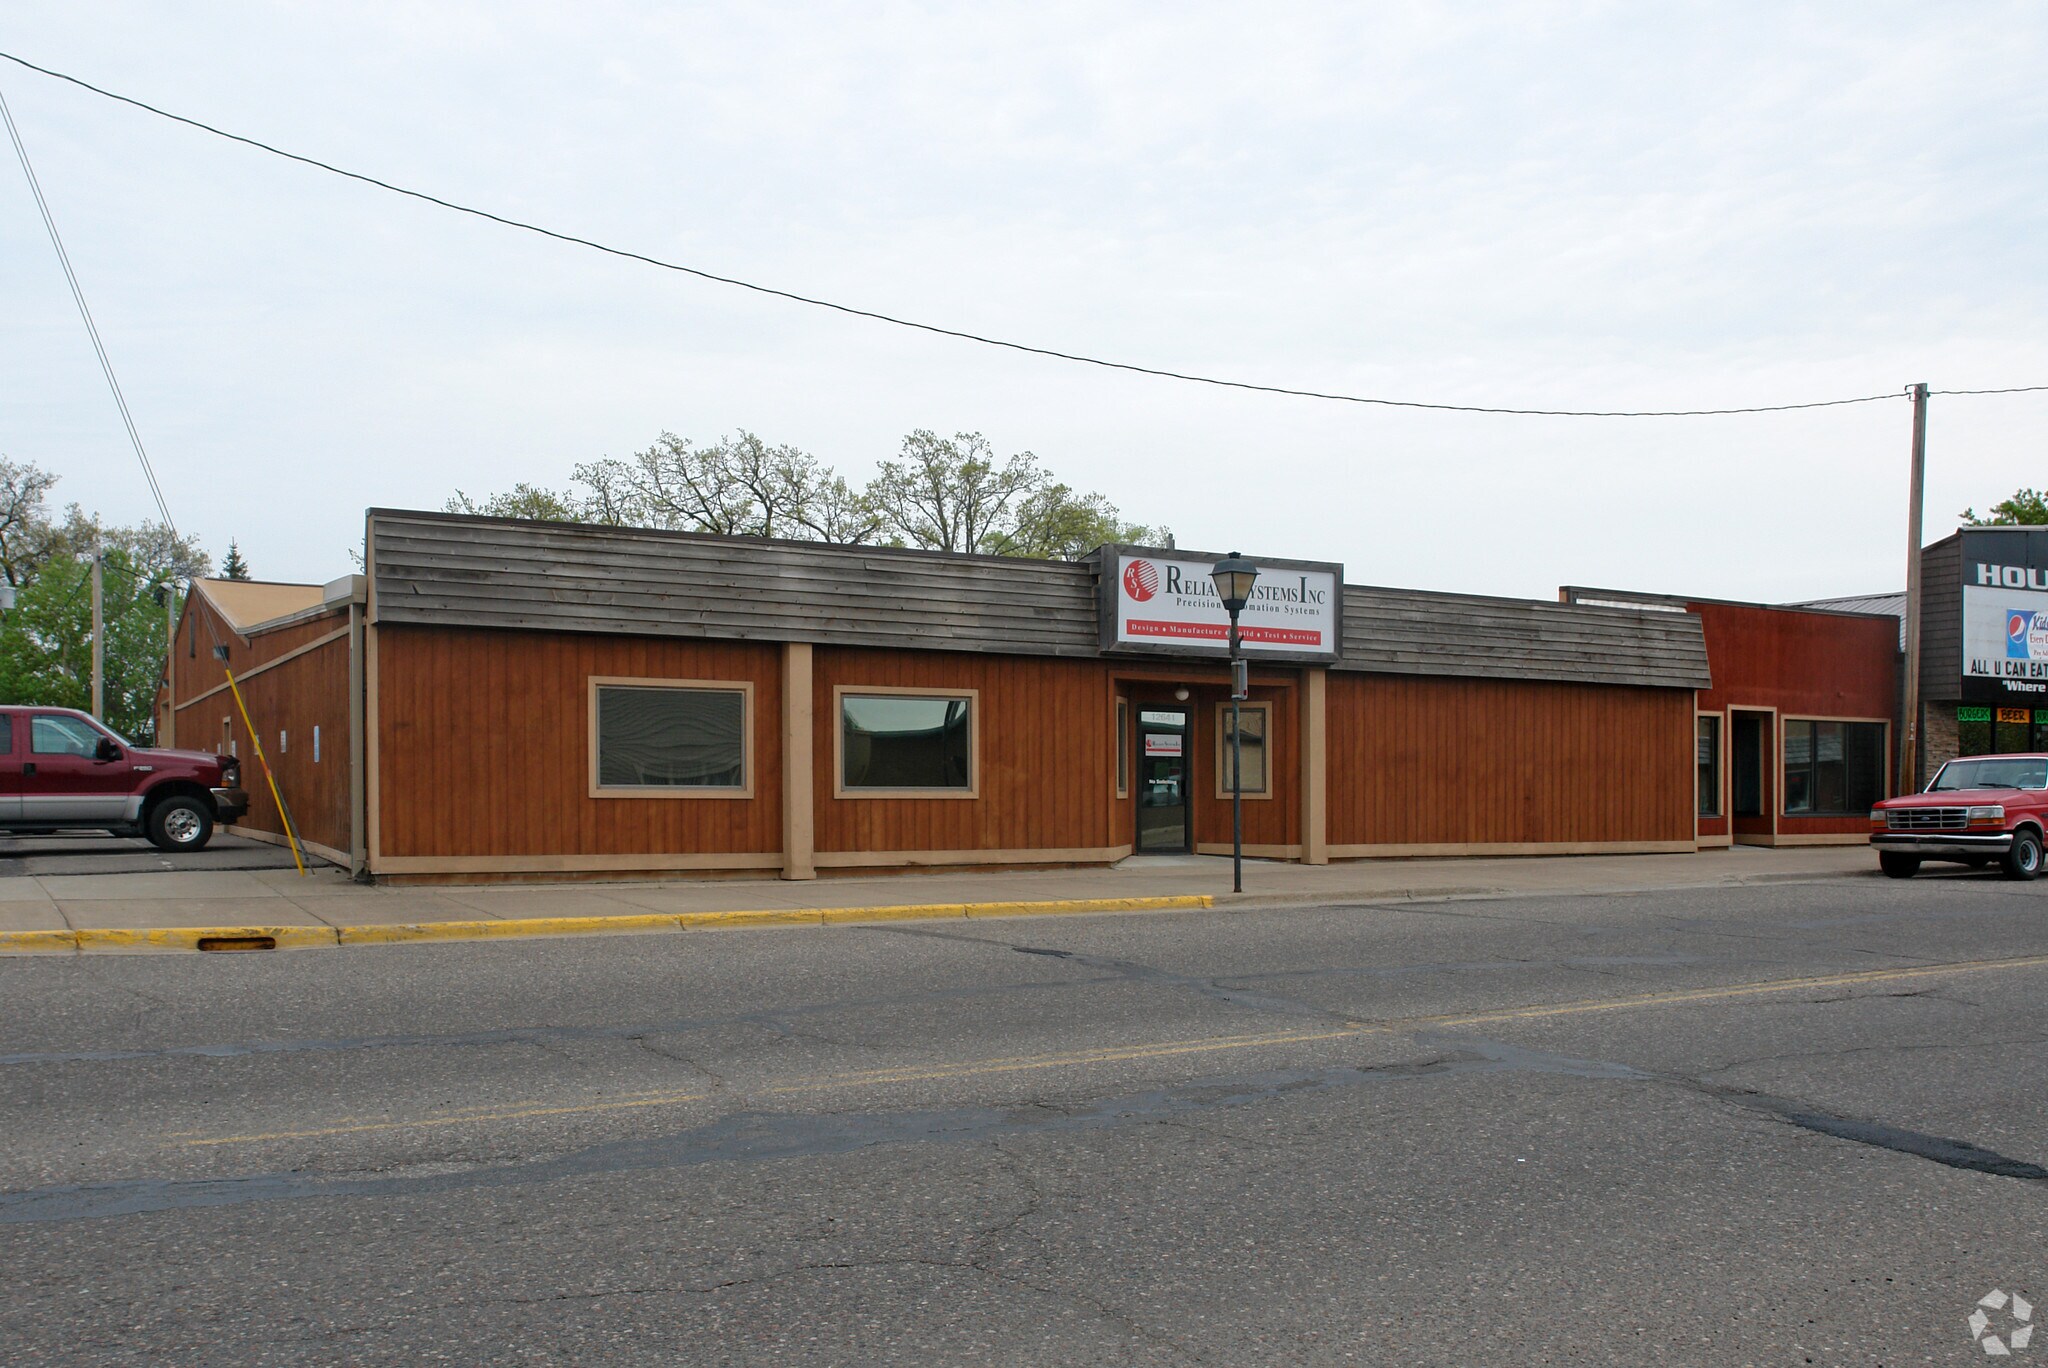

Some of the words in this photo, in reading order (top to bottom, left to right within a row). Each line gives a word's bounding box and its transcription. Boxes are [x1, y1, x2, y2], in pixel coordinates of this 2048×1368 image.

[1176, 597, 1221, 609] Precision
[1284, 605, 1320, 617] Systems
[1131, 623, 1160, 633] Design
[1169, 625, 1222, 636] Manufacture
[1237, 630, 1254, 638] uild
[1263, 631, 1280, 639] Test
[1289, 632, 1318, 642] Service
[1971, 659, 1989, 674] ALL
[1994, 661, 2001, 675] U
[2006, 661, 2026, 677] CAN
[2001, 709, 2025, 721] BEER
